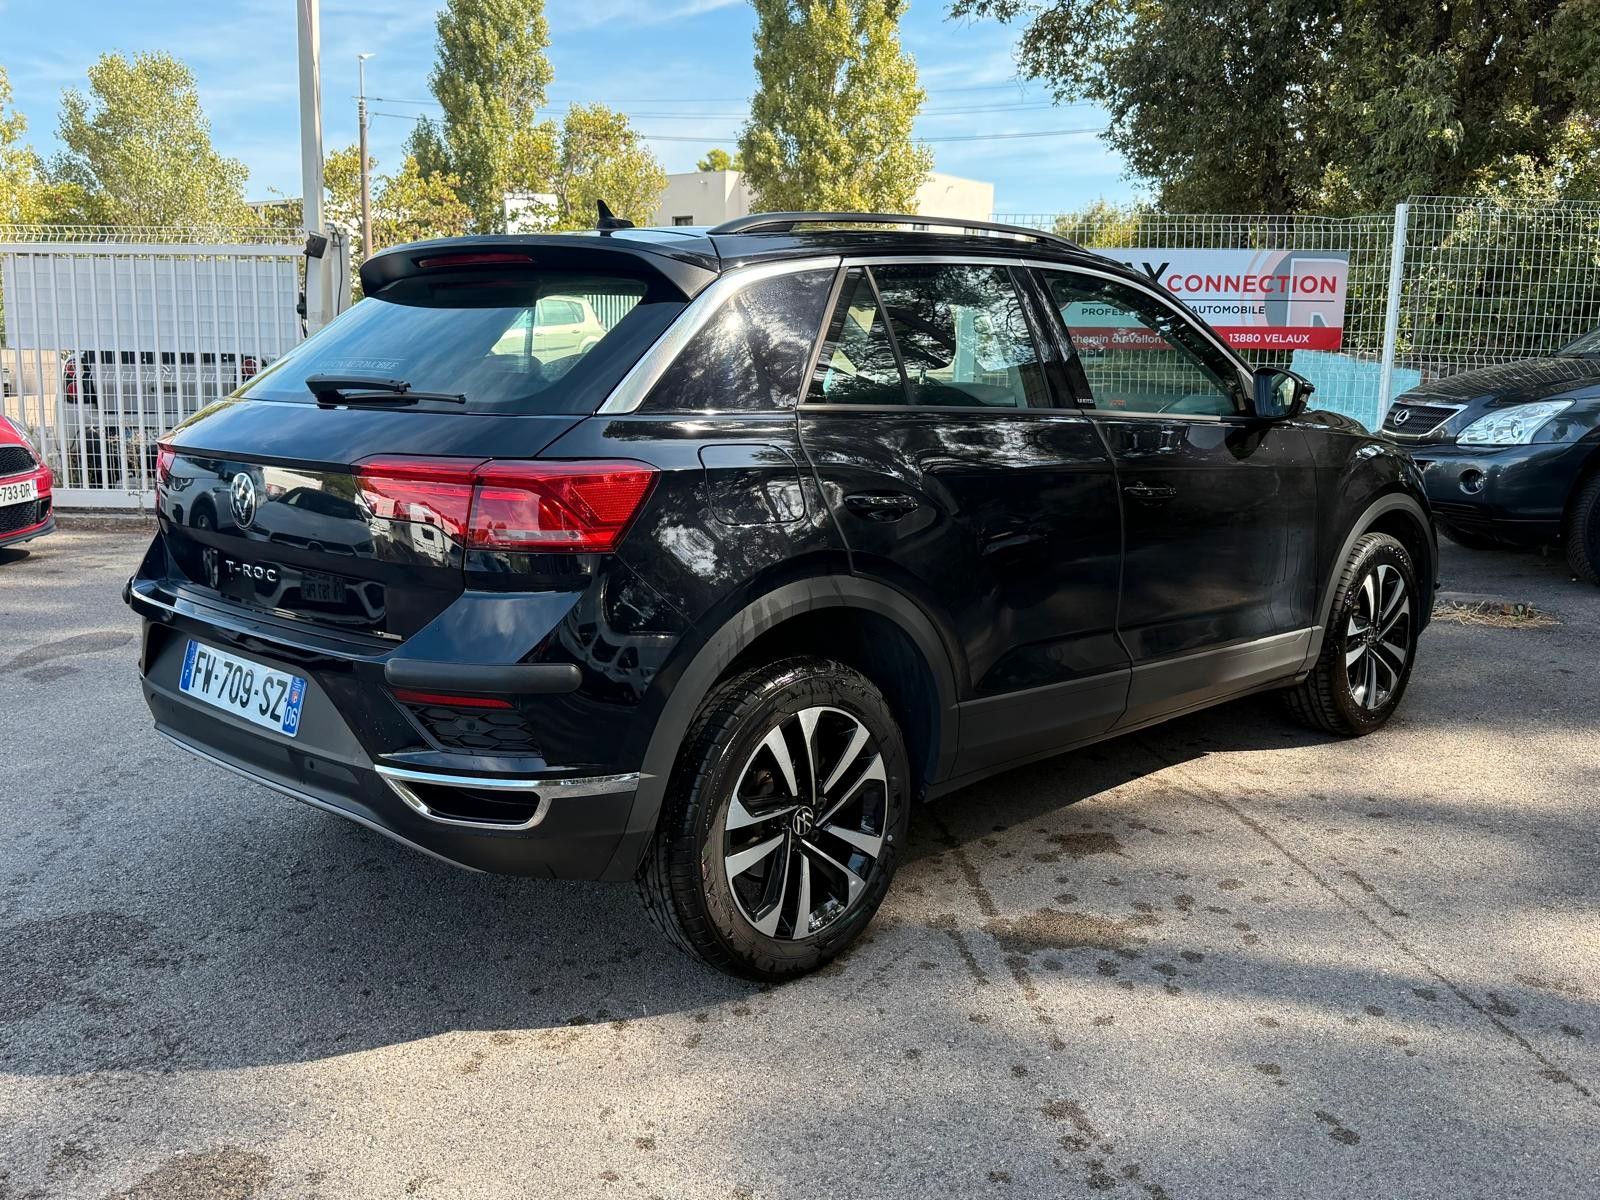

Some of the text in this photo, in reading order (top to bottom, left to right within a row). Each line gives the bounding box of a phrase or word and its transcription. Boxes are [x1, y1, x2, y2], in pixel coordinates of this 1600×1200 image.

[1167, 274, 1337, 293] CONNECTION
[1081, 308, 1128, 317] PROFES
[1128, 333, 1162, 344] Vallon
[1228, 333, 1261, 343] 13880
[1264, 334, 1310, 343] VELAUX
[225, 560, 277, 582] T-ROC
[191, 651, 288, 724] FW-709-SZ
[284, 705, 298, 727] 06
